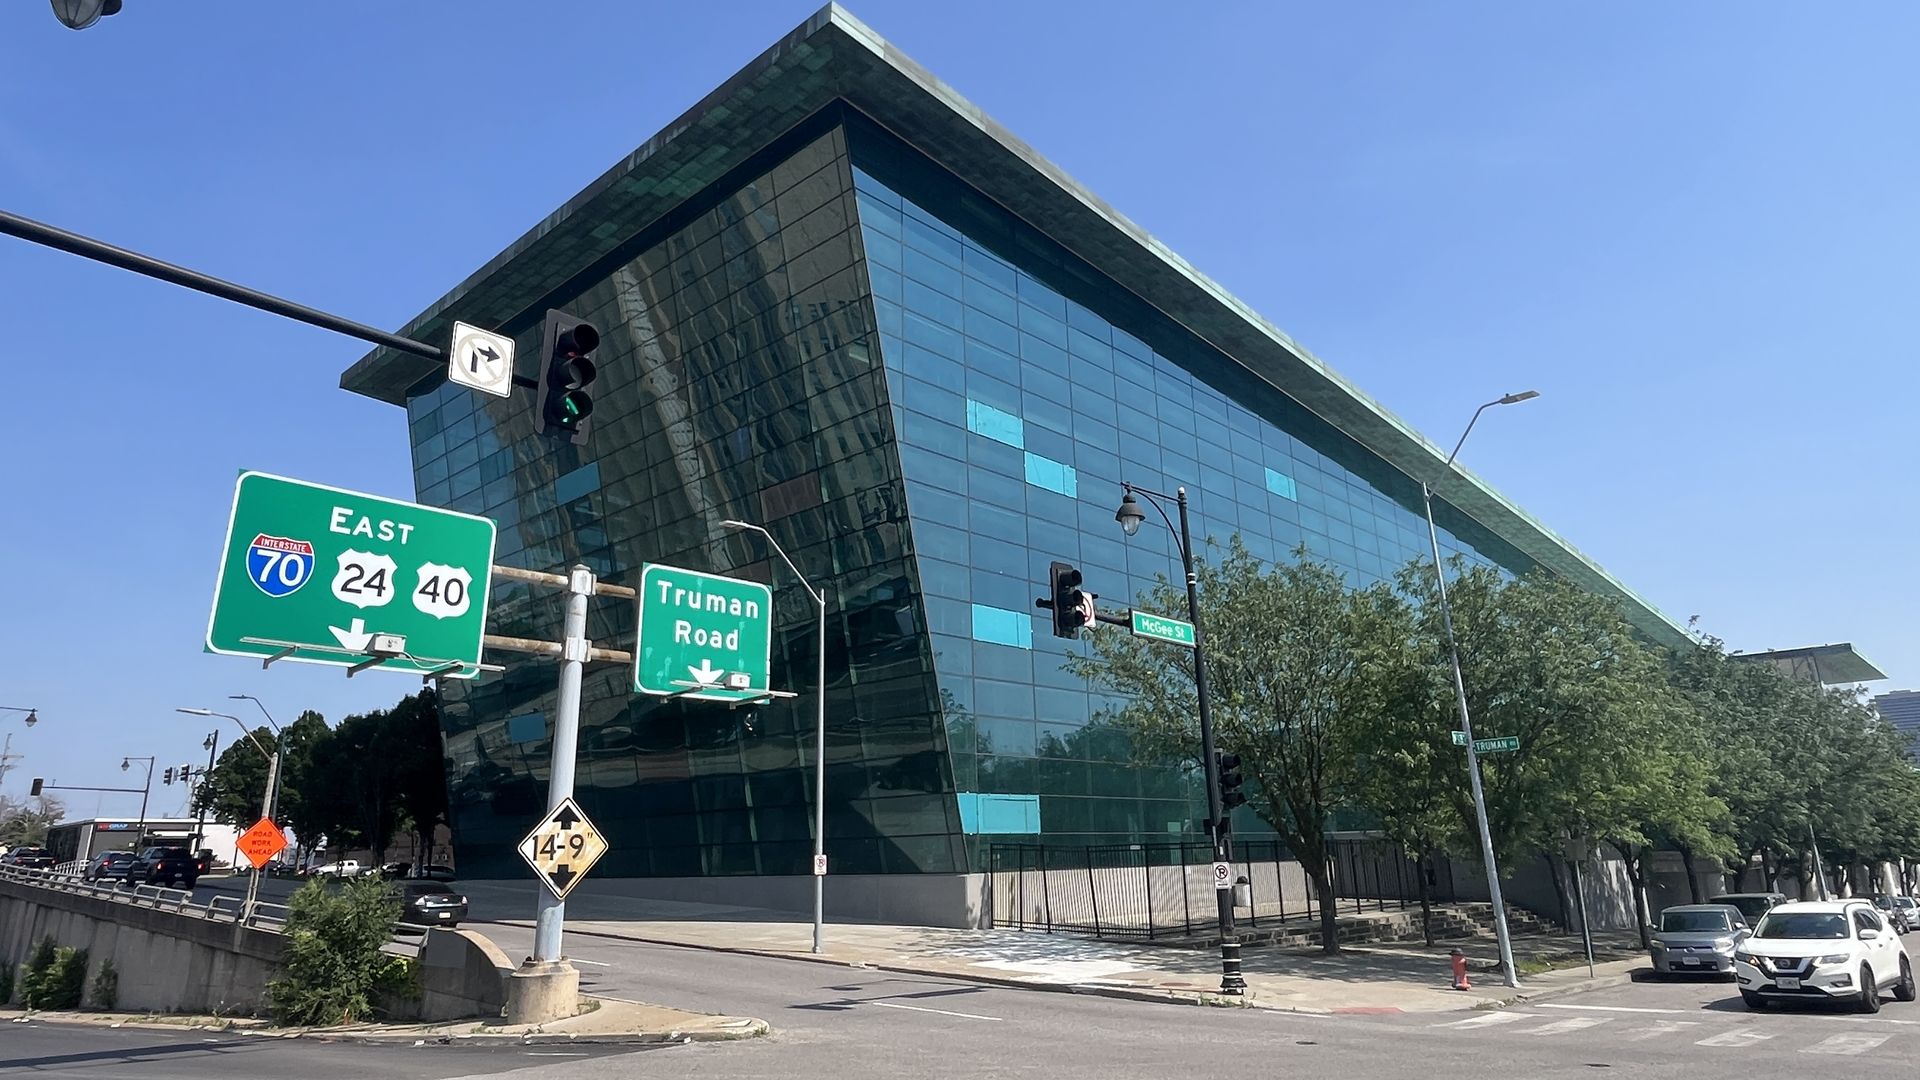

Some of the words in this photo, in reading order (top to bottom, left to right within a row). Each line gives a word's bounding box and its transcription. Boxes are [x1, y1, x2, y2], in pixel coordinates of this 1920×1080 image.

[329, 506, 414, 545] EAST
[260, 537, 307, 553] INTERSTATE
[257, 549, 305, 586] 70
[340, 563, 387, 597] 24
[418, 575, 465, 606] 40
[657, 579, 759, 619] Truman
[674, 619, 739, 651] Road
[1141, 618, 1173, 636] McGee
[1174, 625, 1185, 638] St
[1475, 740, 1508, 751] TRUMAN
[251, 839, 272, 847] WORK
[252, 830, 273, 838] ROAD
[247, 848, 273, 856] AHEAD
